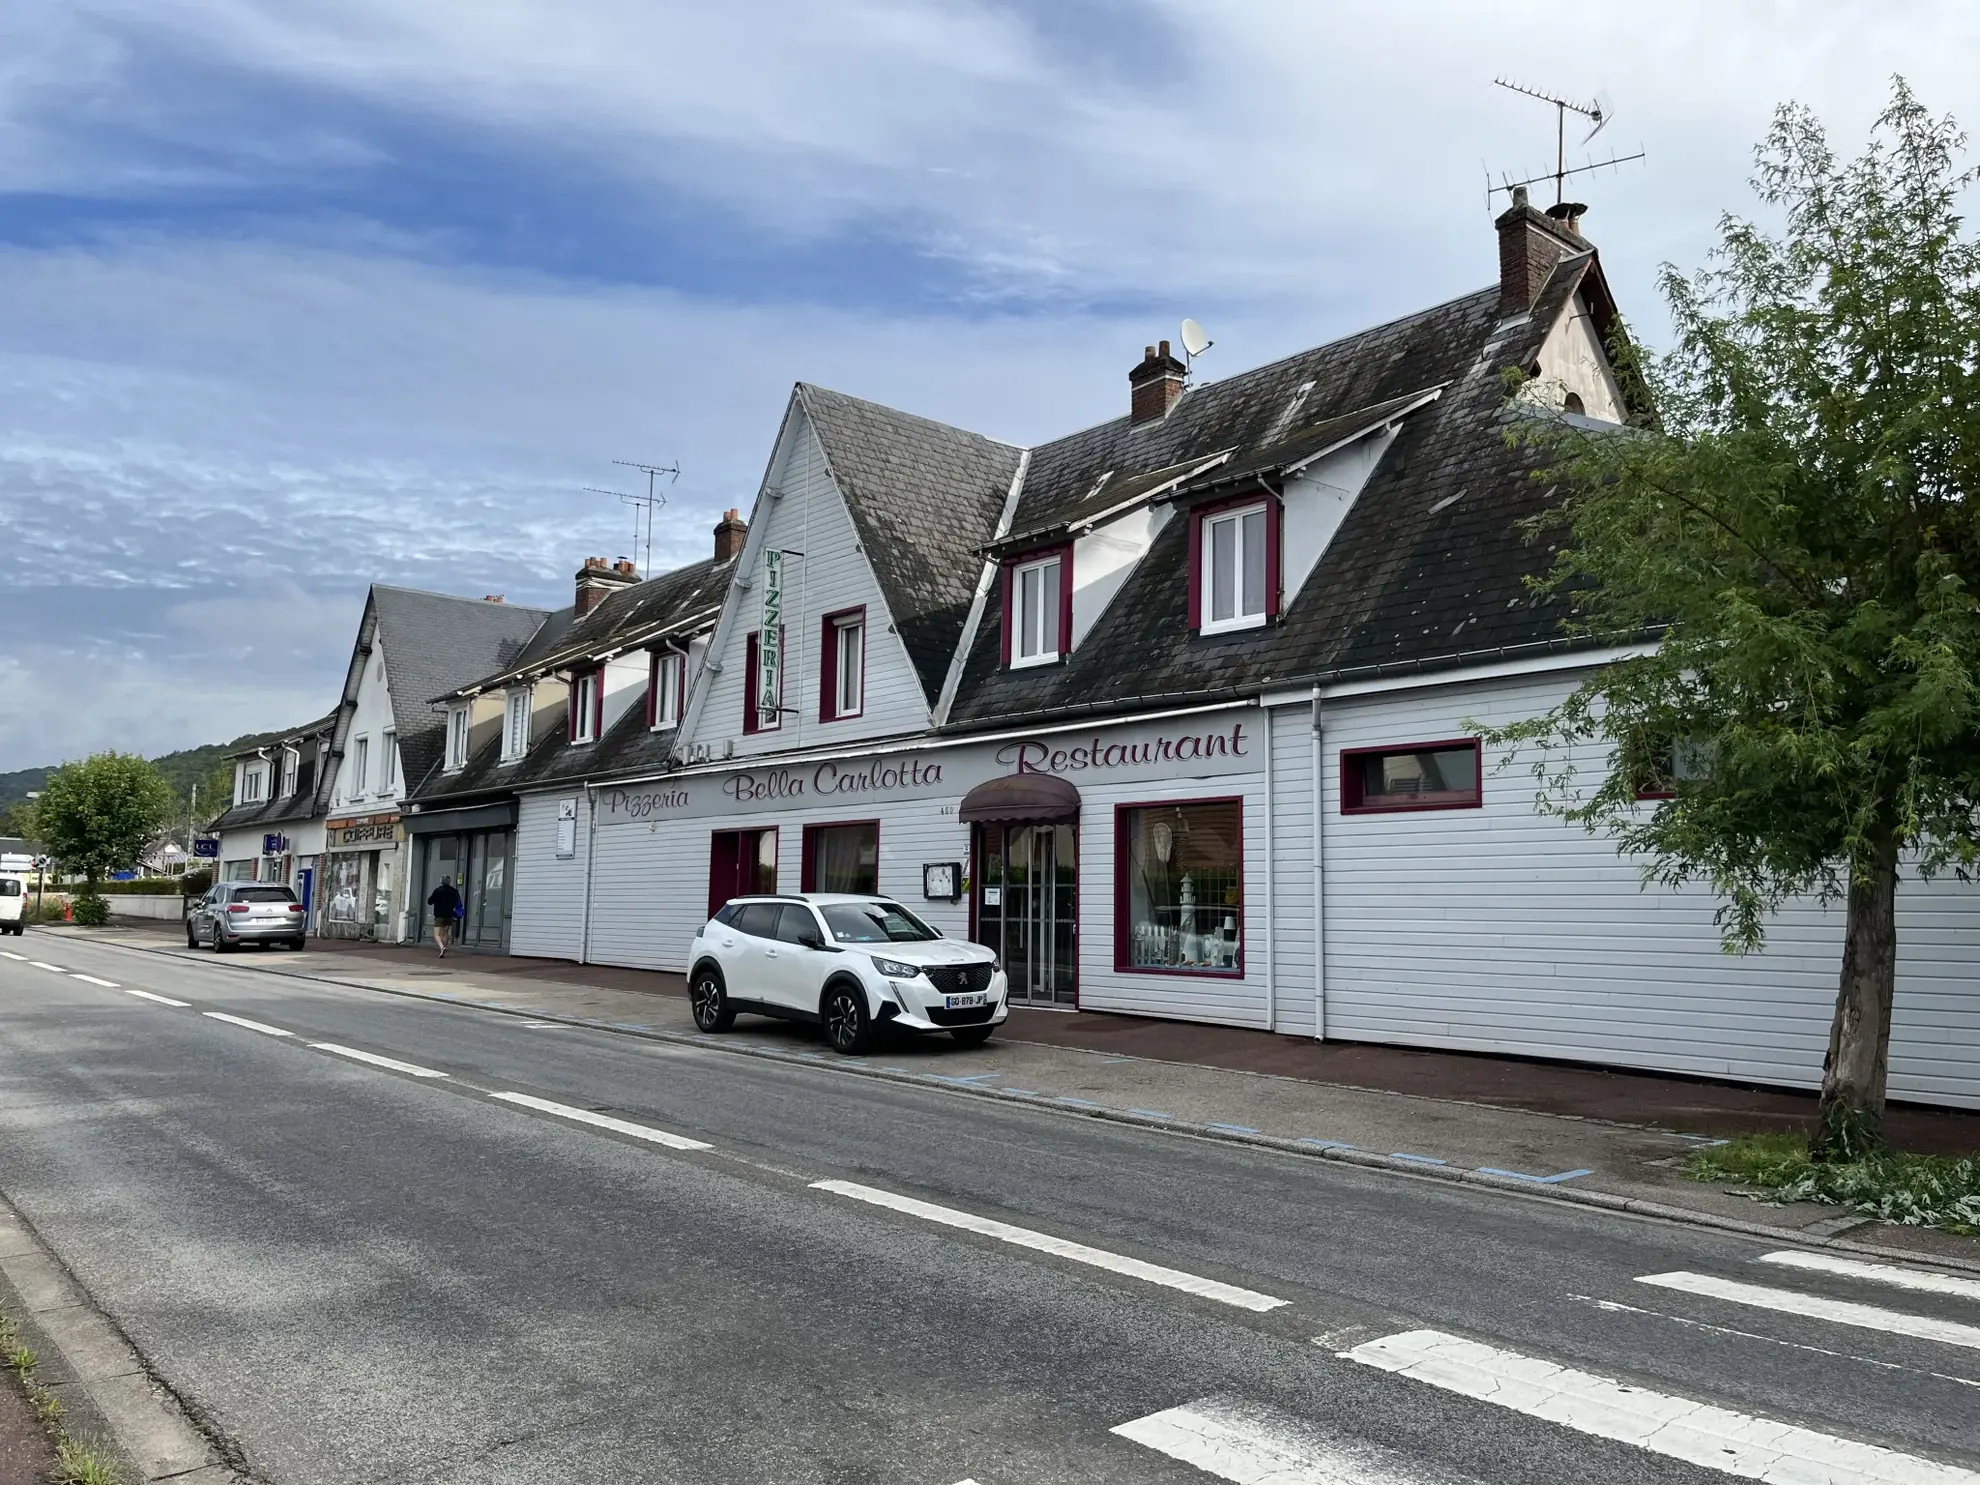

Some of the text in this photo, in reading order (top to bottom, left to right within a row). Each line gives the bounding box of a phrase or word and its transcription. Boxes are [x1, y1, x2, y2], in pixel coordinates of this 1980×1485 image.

[761, 550, 781, 707] PIZZERIA
[602, 724, 1249, 818] Pizzeria Bella Carlotta Restaurant
[343, 825, 394, 843] COIFFURE
